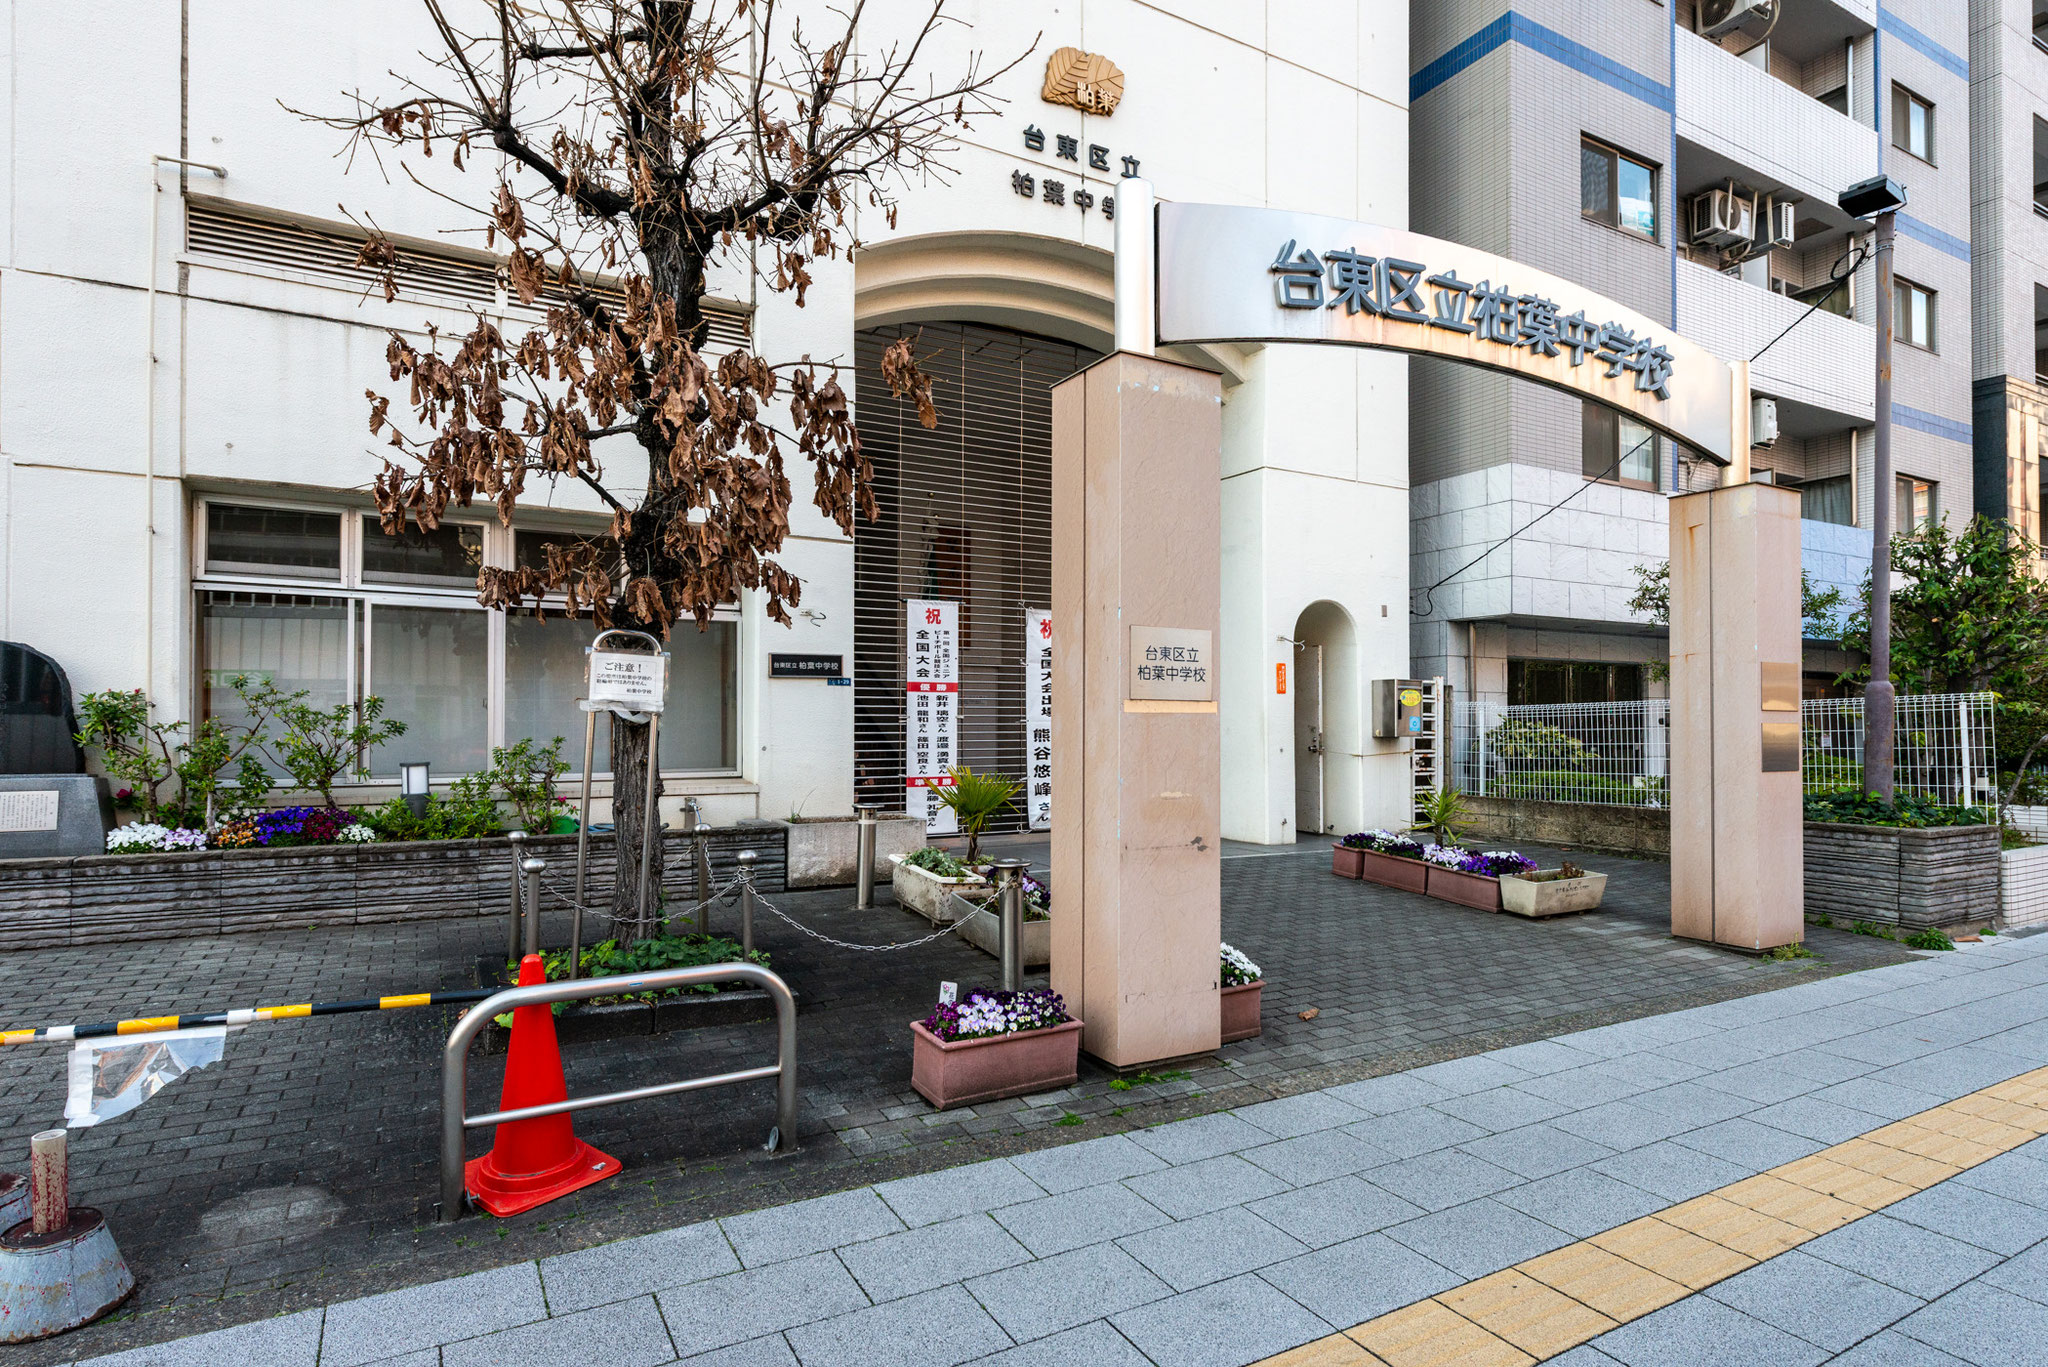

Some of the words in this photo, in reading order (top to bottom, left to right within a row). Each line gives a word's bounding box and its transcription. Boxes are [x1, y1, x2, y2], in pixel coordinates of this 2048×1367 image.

[1022, 123, 1141, 179] 台東区立
[1270, 238, 1676, 401] 台東区立柏葉中学校
[925, 607, 942, 625] 祝
[916, 629, 930, 678] 全国大会
[1144, 644, 1200, 664] 台東区立
[773, 661, 798, 669] 台東区立
[799, 661, 839, 671] 柏葉中学校
[1137, 664, 1207, 684] 柏葉中学校
[919, 683, 947, 691] 優勝
[917, 694, 929, 708] 池田
[936, 694, 949, 708] 新井
